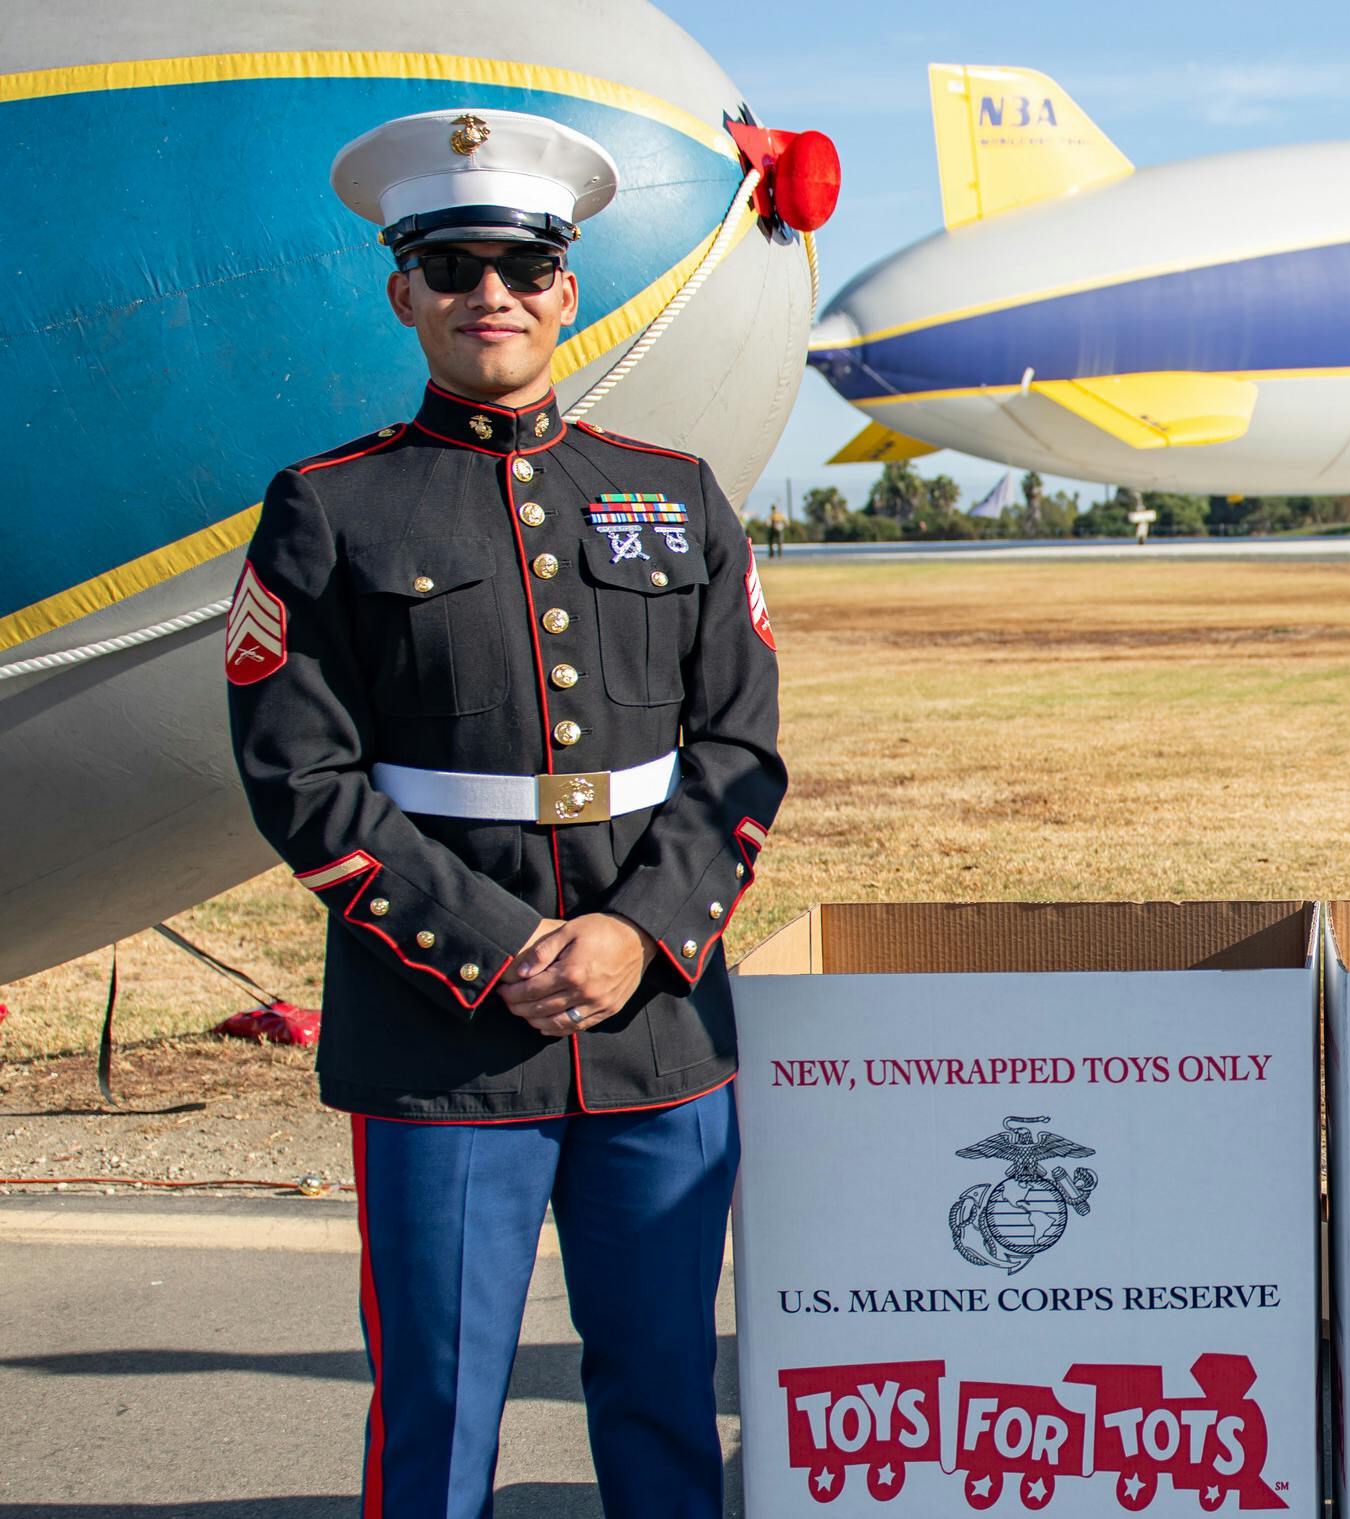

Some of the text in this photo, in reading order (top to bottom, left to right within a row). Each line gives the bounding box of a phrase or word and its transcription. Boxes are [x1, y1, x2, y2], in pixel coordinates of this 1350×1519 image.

[979, 96, 1057, 127] N3A
[771, 1054, 1272, 1090] NEW, UNWRAPPED TOYS ONLY
[779, 1284, 1280, 1313] U.S. MARINE CORPS RESERVE
[796, 1380, 1245, 1476] TOYS FOR TOTS
[1274, 1481, 1289, 1491] SM
